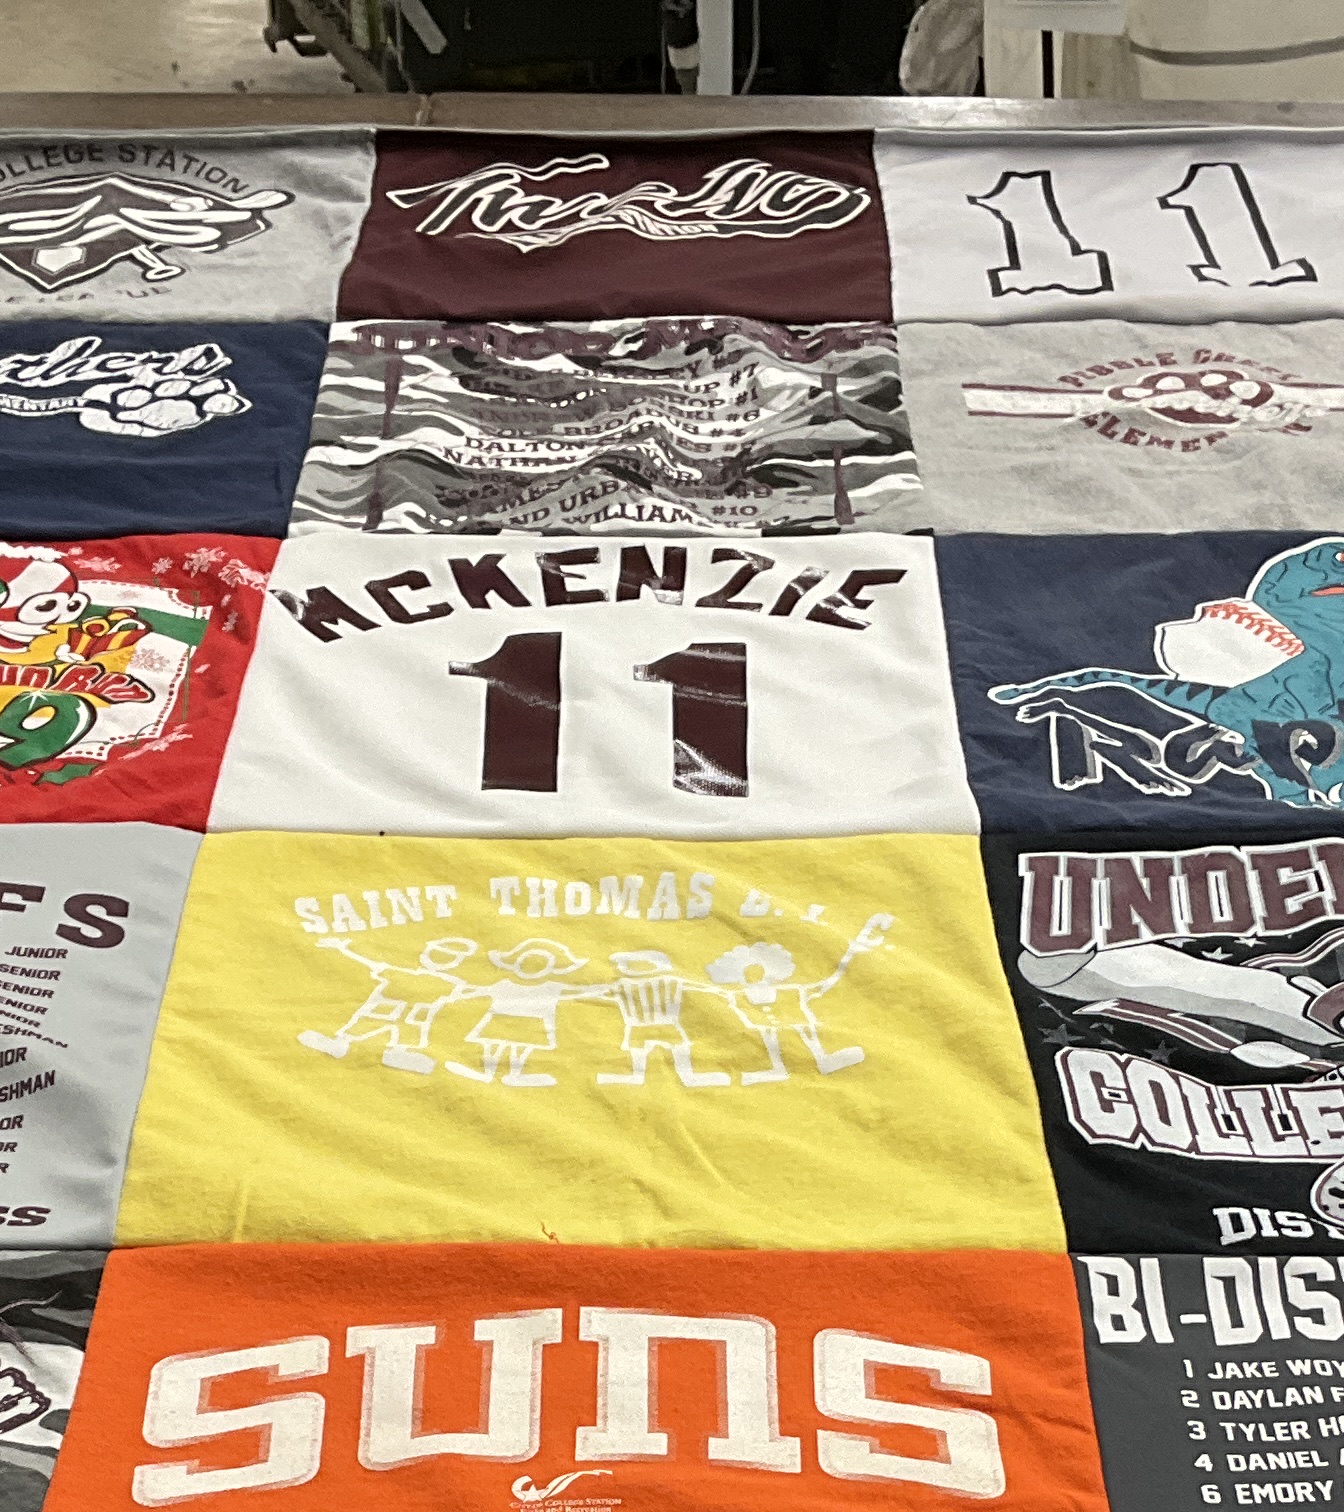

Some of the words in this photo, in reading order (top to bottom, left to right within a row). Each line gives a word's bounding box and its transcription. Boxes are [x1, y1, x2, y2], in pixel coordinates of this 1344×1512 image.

[117, 145, 252, 194] STATION
[269, 542, 908, 642] MCKENZIE
[447, 631, 750, 799] 11
[293, 885, 458, 934] SAINT
[489, 872, 714, 921] THOMAS
[1183, 1360, 1193, 1379] 1
[1208, 1360, 1279, 1380] JAKE
[1187, 1420, 1207, 1441] 3
[1220, 1421, 1311, 1442] TYLER
